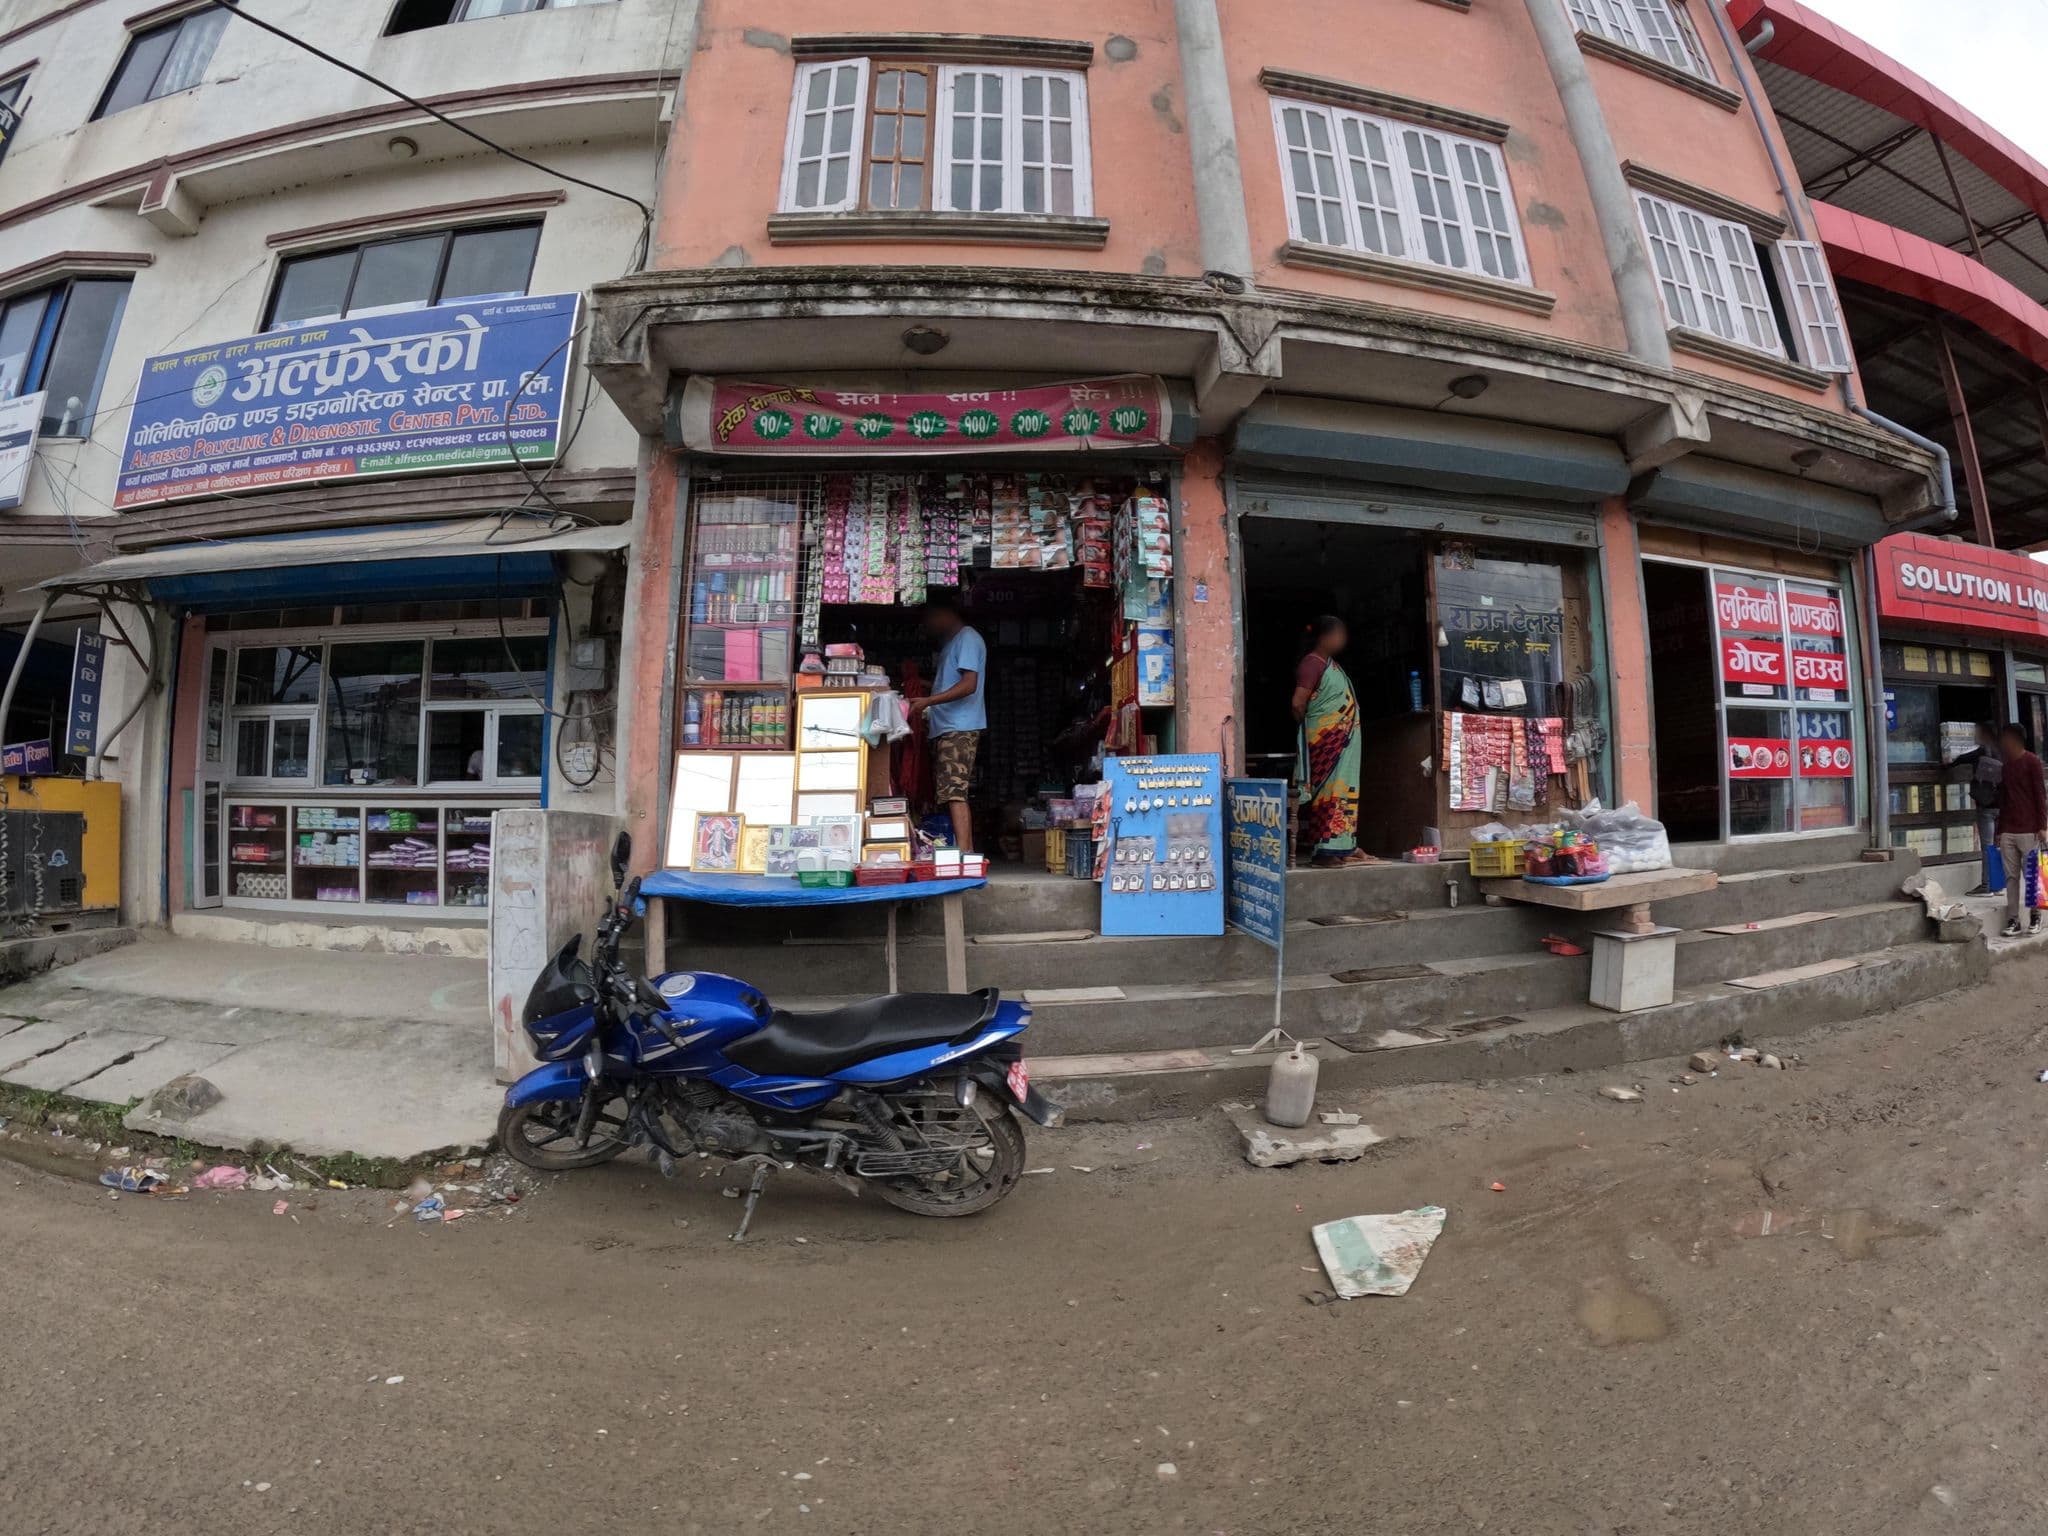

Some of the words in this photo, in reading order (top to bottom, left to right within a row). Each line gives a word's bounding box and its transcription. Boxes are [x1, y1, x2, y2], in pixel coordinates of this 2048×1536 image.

[152, 358, 179, 373] नेपाल
[184, 350, 219, 367] सरकार
[225, 343, 249, 359] द्वारा
[255, 336, 295, 351] मान्यता
[300, 330, 329, 345] प्राप्त
[232, 314, 489, 402] अल्फ्रेस्को
[134, 411, 238, 446] पोलिक्लिनिक
[243, 406, 281, 427] एण्ड
[285, 388, 408, 421] डाइग्नोस्टिक
[413, 381, 476, 406] सेन्टर
[483, 377, 509, 401] प्रा.
[519, 371, 554, 397] लि.
[717, 403, 747, 442] हरेक
[270, 426, 285, 447] &
[302, 448, 322, 461] फोन
[360, 454, 394, 469] E-mail:
[1901, 562, 2012, 604] SOLUTION
[1450, 606, 1510, 633] राजन
[1719, 587, 1779, 629] लुम्बिनी
[1789, 601, 1841, 633] गण्डकी
[1728, 642, 1780, 675] गेष्ट
[1794, 656, 1844, 682] हाउस
[75, 692, 93, 740] पसल
